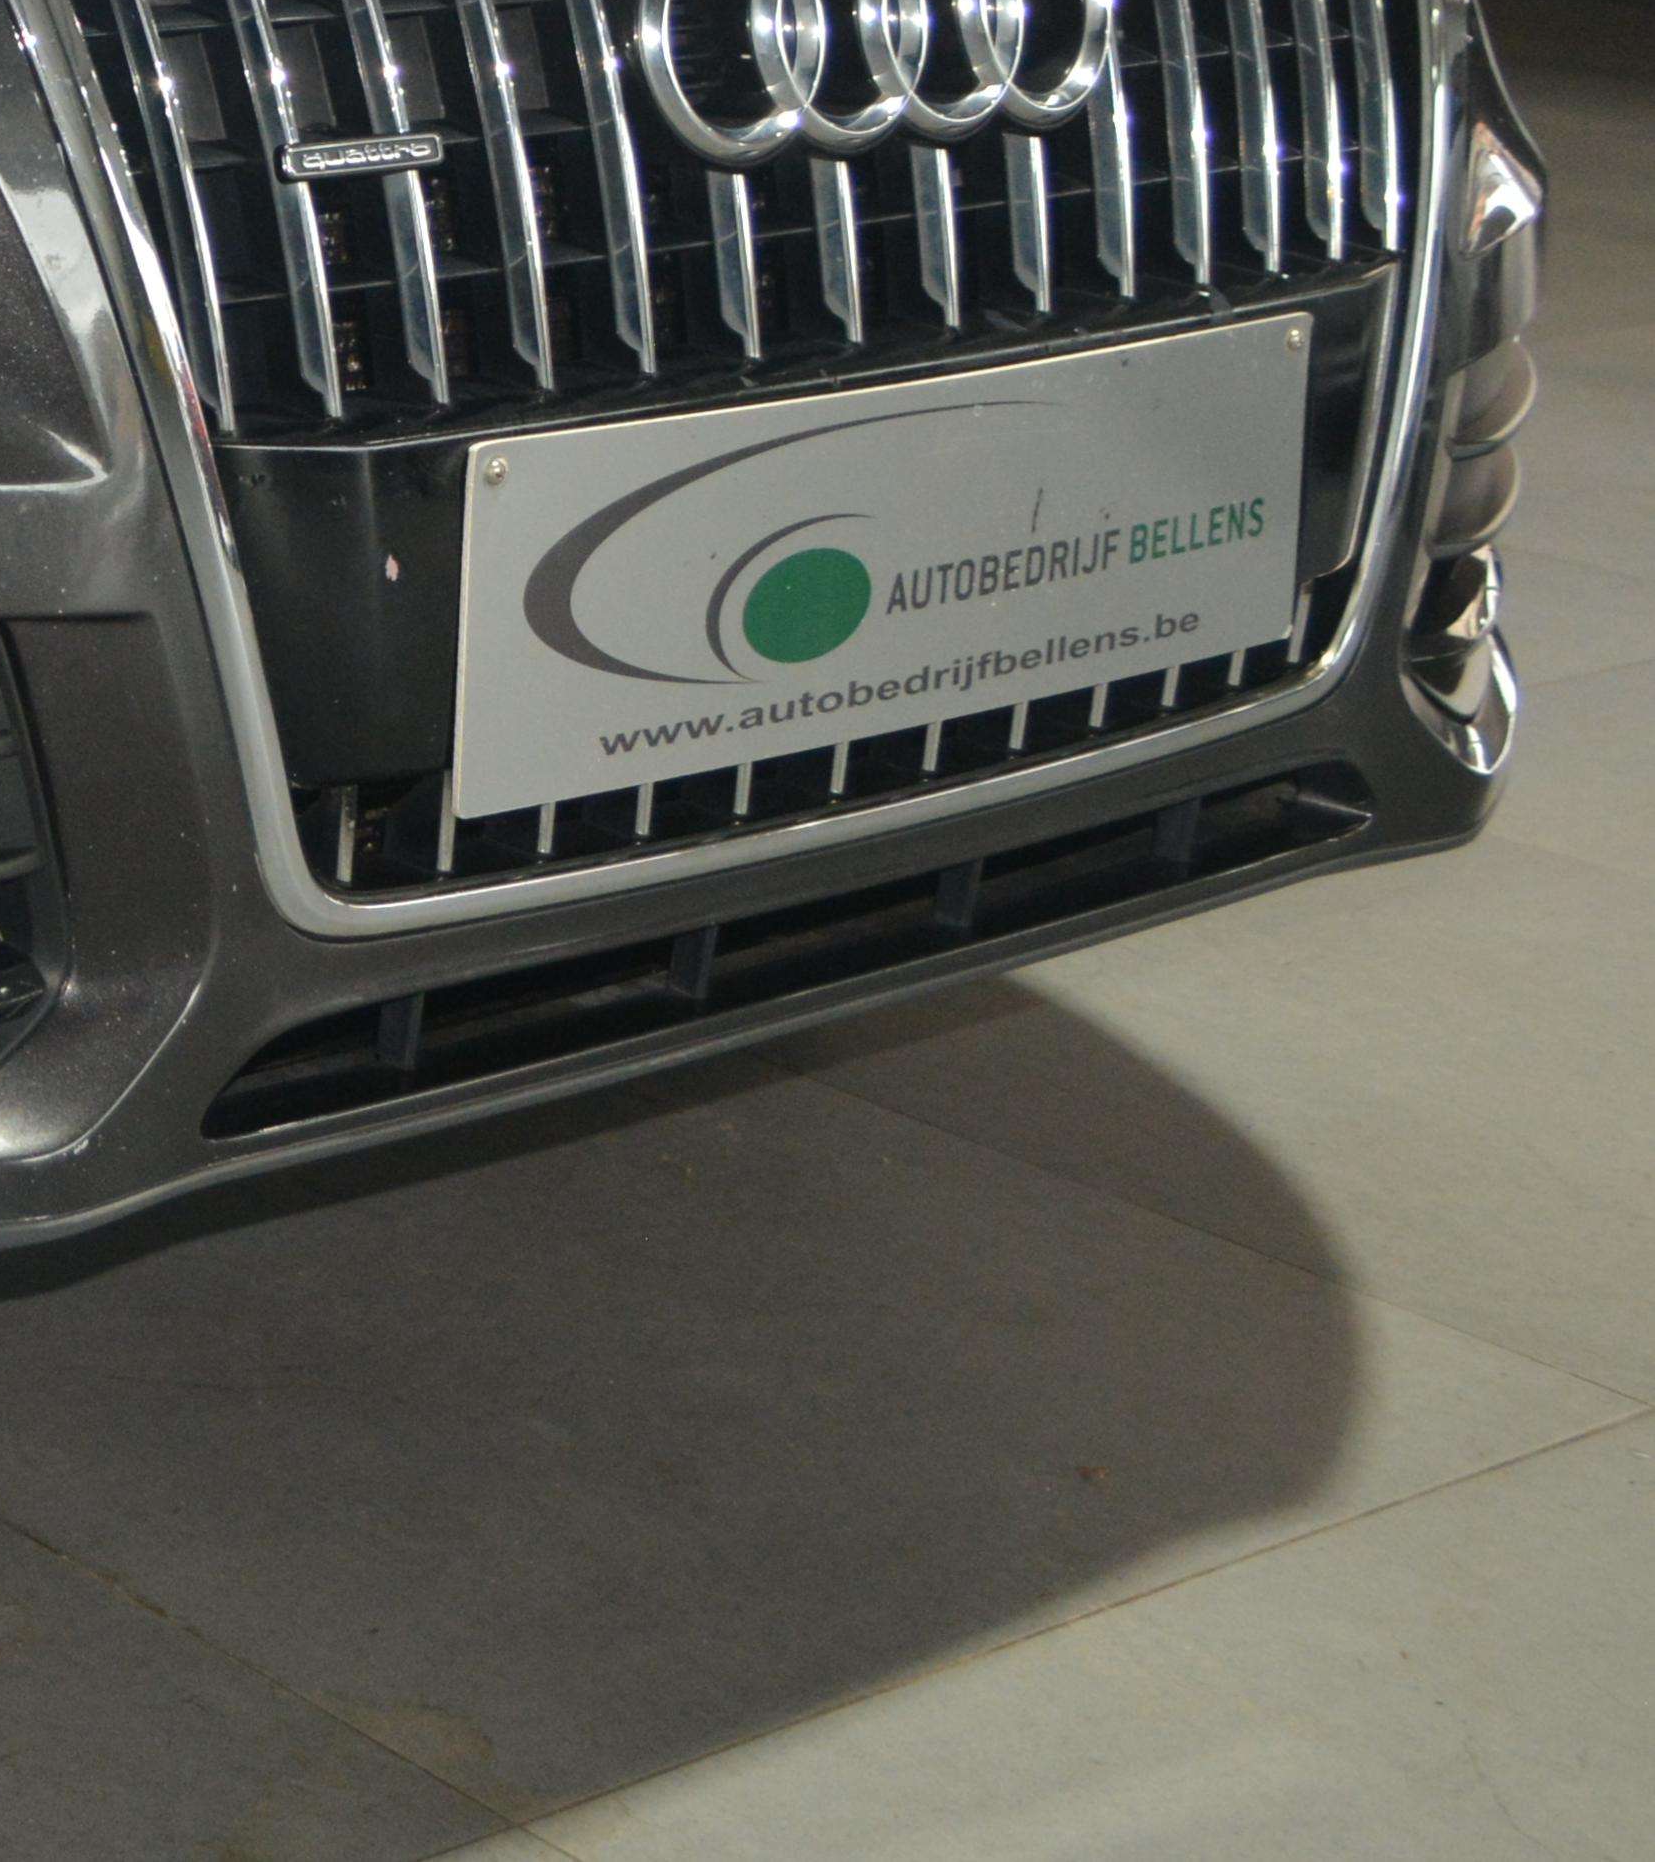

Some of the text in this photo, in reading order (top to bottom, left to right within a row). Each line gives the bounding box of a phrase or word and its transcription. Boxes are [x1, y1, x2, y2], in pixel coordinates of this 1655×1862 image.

[301, 142, 432, 171] quattro
[885, 497, 1265, 615] AUTOBEDRIJF BELLENS
[599, 611, 1201, 757] www.autobedrijfbellens.be
